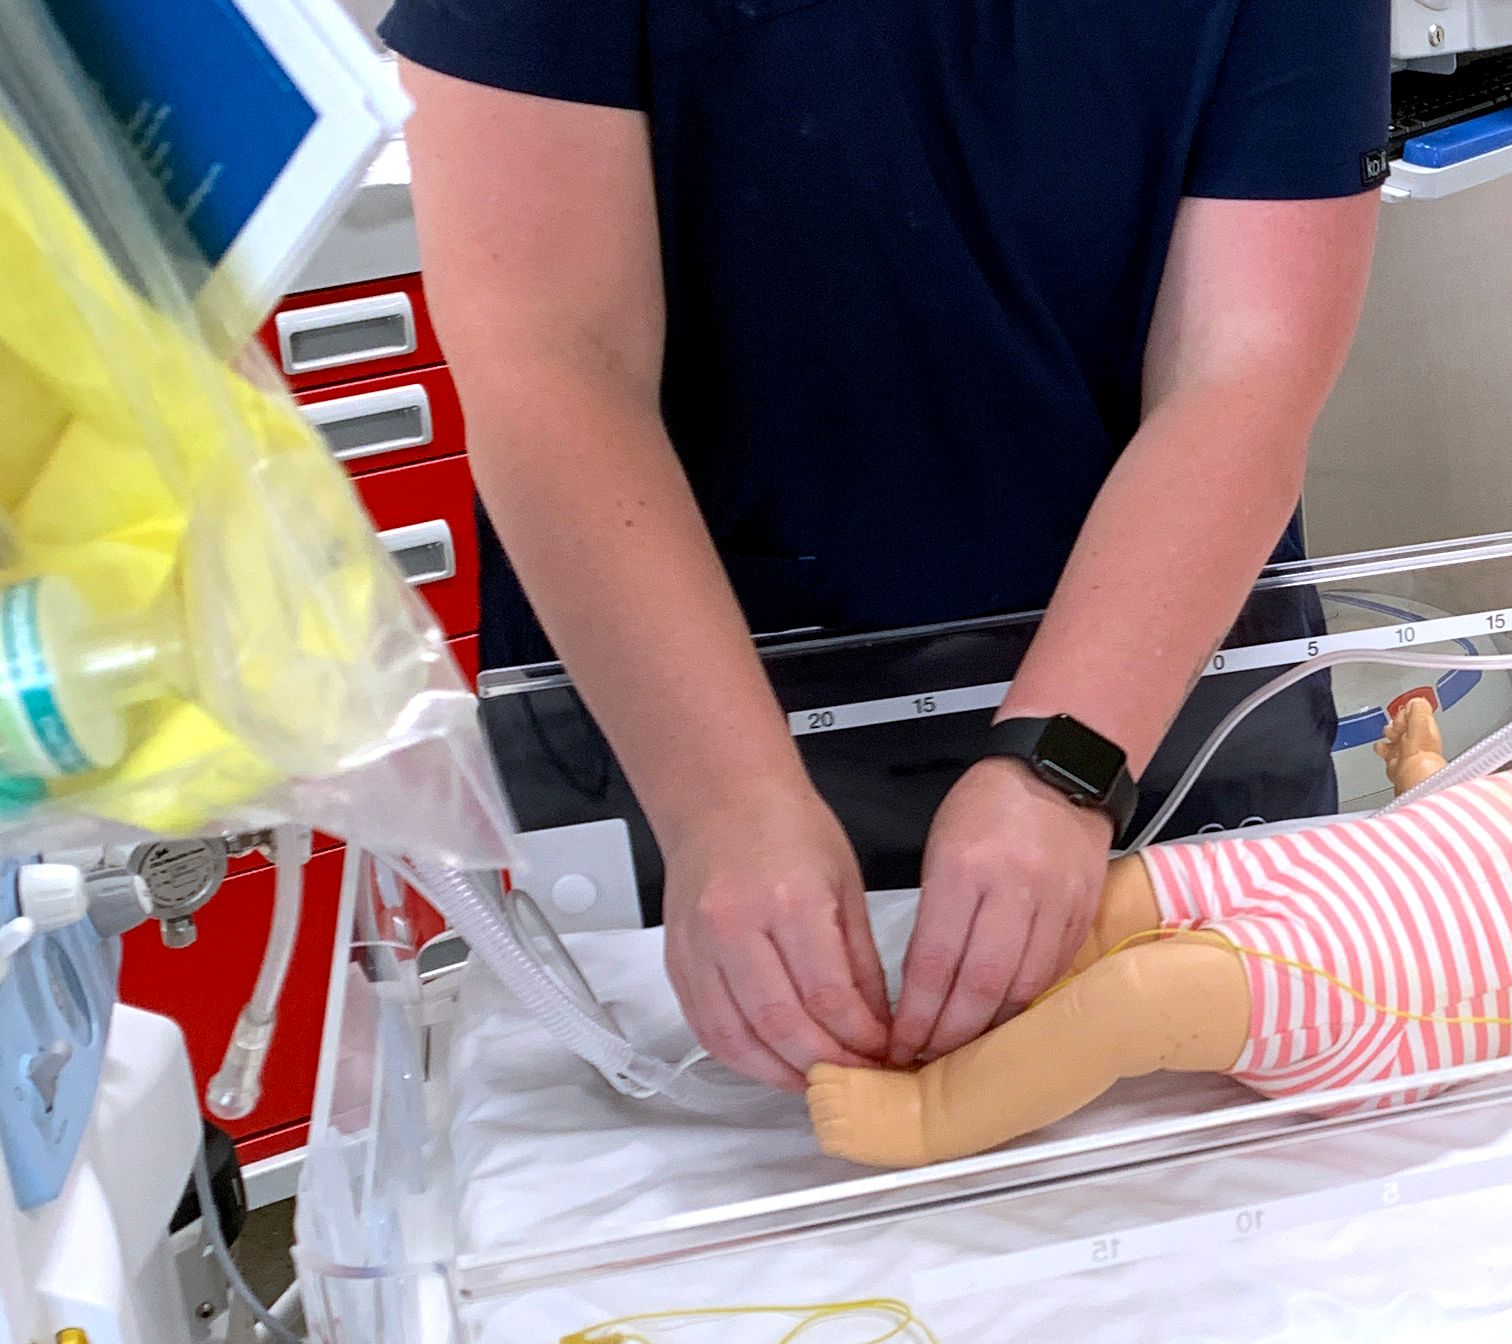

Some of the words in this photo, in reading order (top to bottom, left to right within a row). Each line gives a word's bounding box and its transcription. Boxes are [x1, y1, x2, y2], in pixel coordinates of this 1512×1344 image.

[807, 710, 836, 730] 20
[912, 696, 937, 715] 15
[1212, 654, 1225, 671] 0
[1307, 640, 1319, 657] 5
[1395, 626, 1416, 644] 10
[1485, 613, 1507, 630] 15
